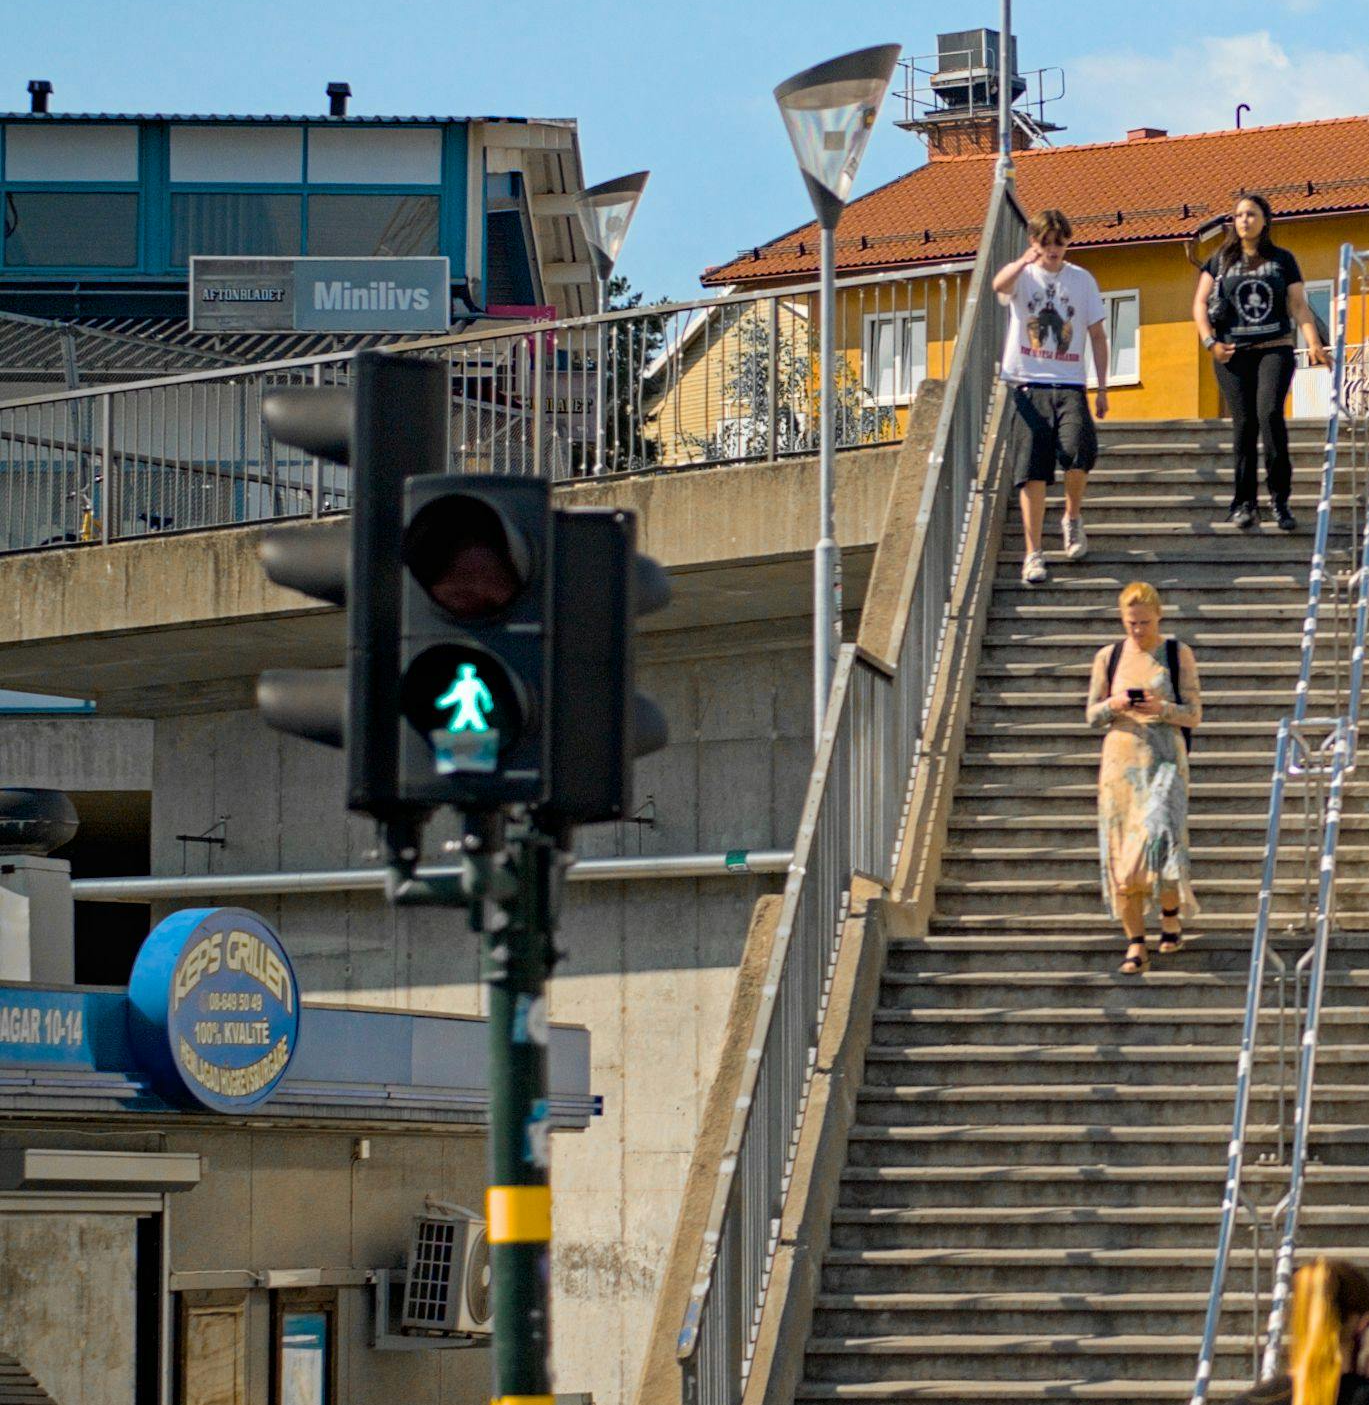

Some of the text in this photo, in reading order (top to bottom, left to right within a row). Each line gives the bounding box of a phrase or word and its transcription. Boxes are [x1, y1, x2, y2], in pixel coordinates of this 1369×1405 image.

[202, 288, 285, 302] AFTONBLADET
[313, 281, 430, 311] Minilivs
[174, 932, 224, 1011] KEPS
[45, 1009, 82, 1046] 10-14
[194, 1021, 222, 1045] 100%
